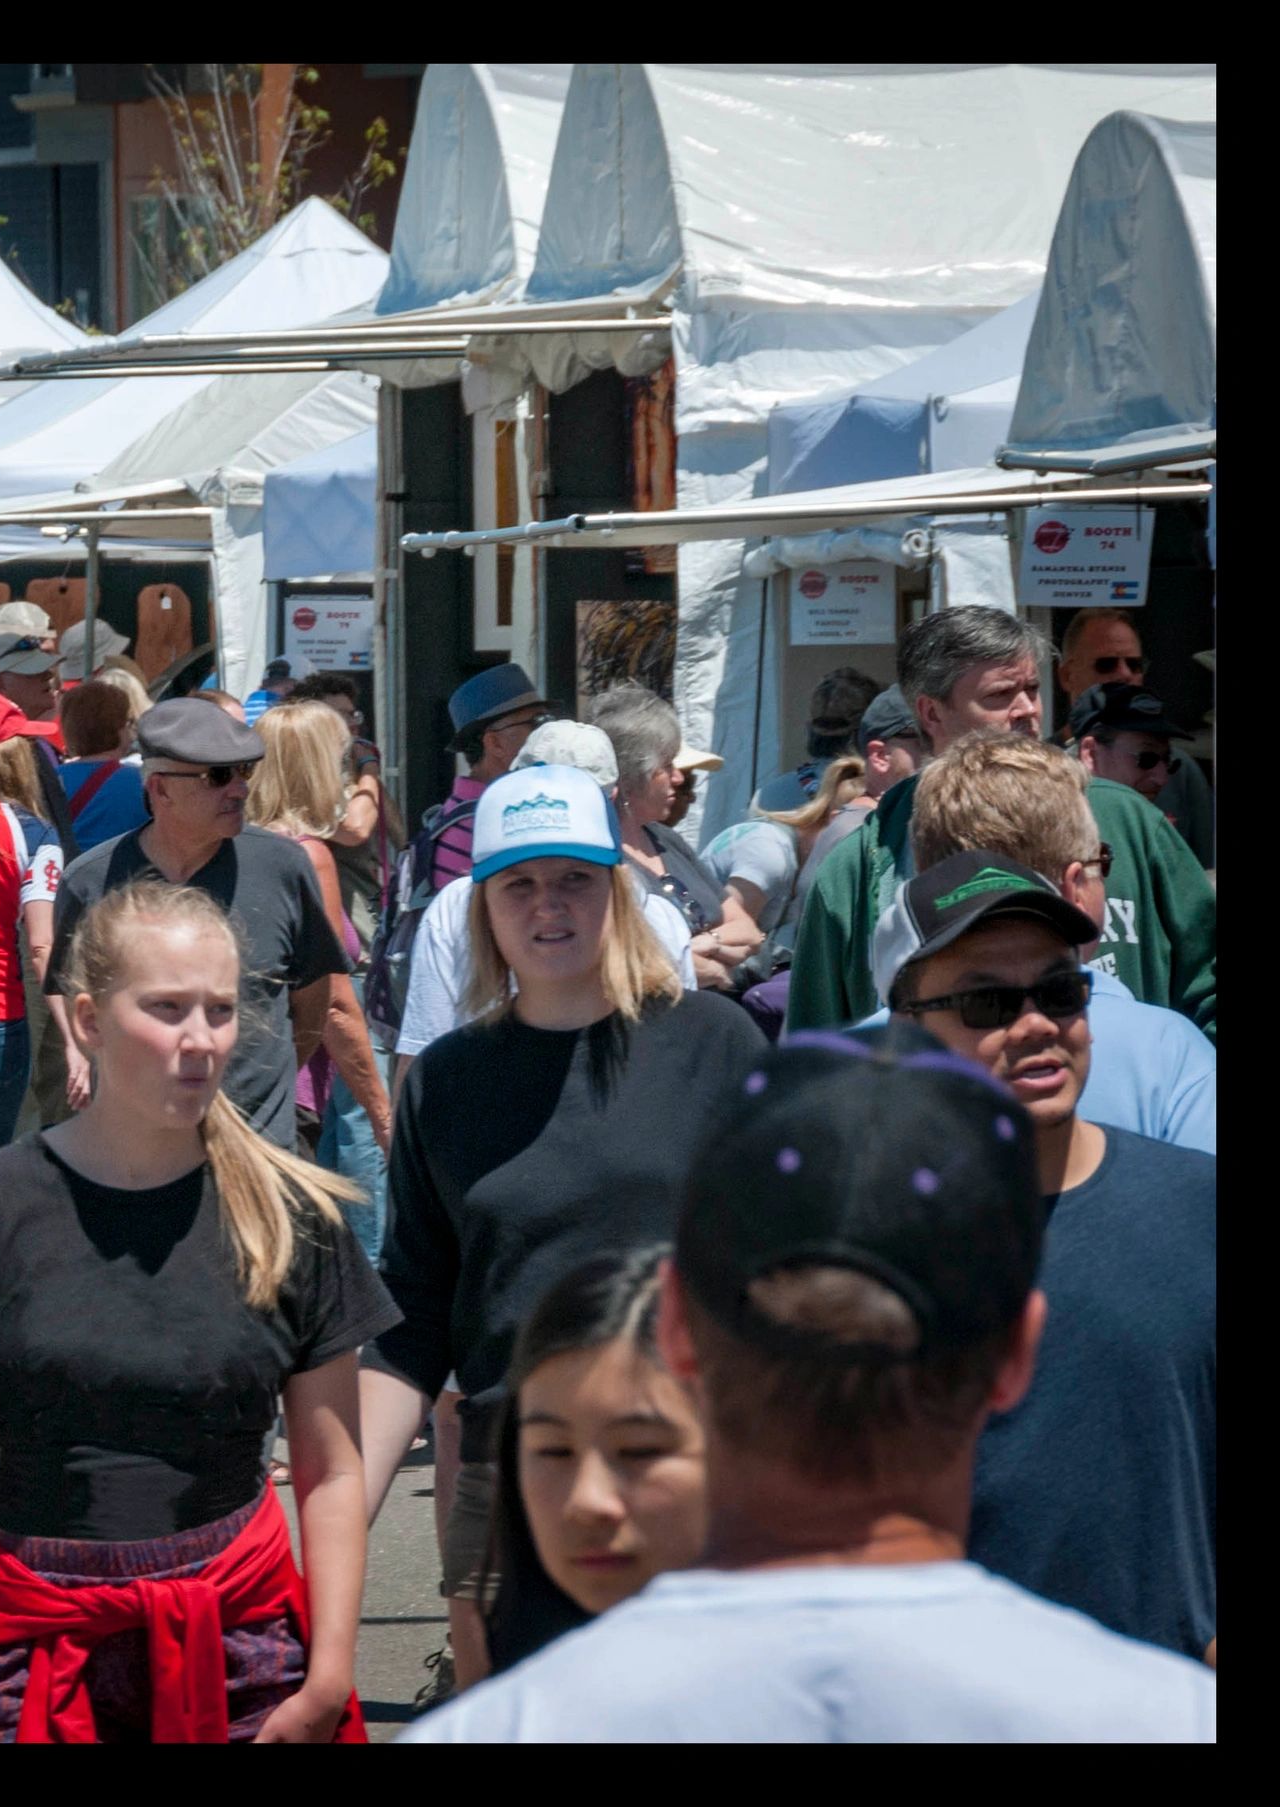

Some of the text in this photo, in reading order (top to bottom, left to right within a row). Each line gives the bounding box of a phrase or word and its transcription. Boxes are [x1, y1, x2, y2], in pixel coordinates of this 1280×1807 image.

[1084, 527, 1133, 537] BOOTH
[1100, 541, 1116, 549] 74
[1037, 578, 1110, 586] PHOTOGRAPHY
